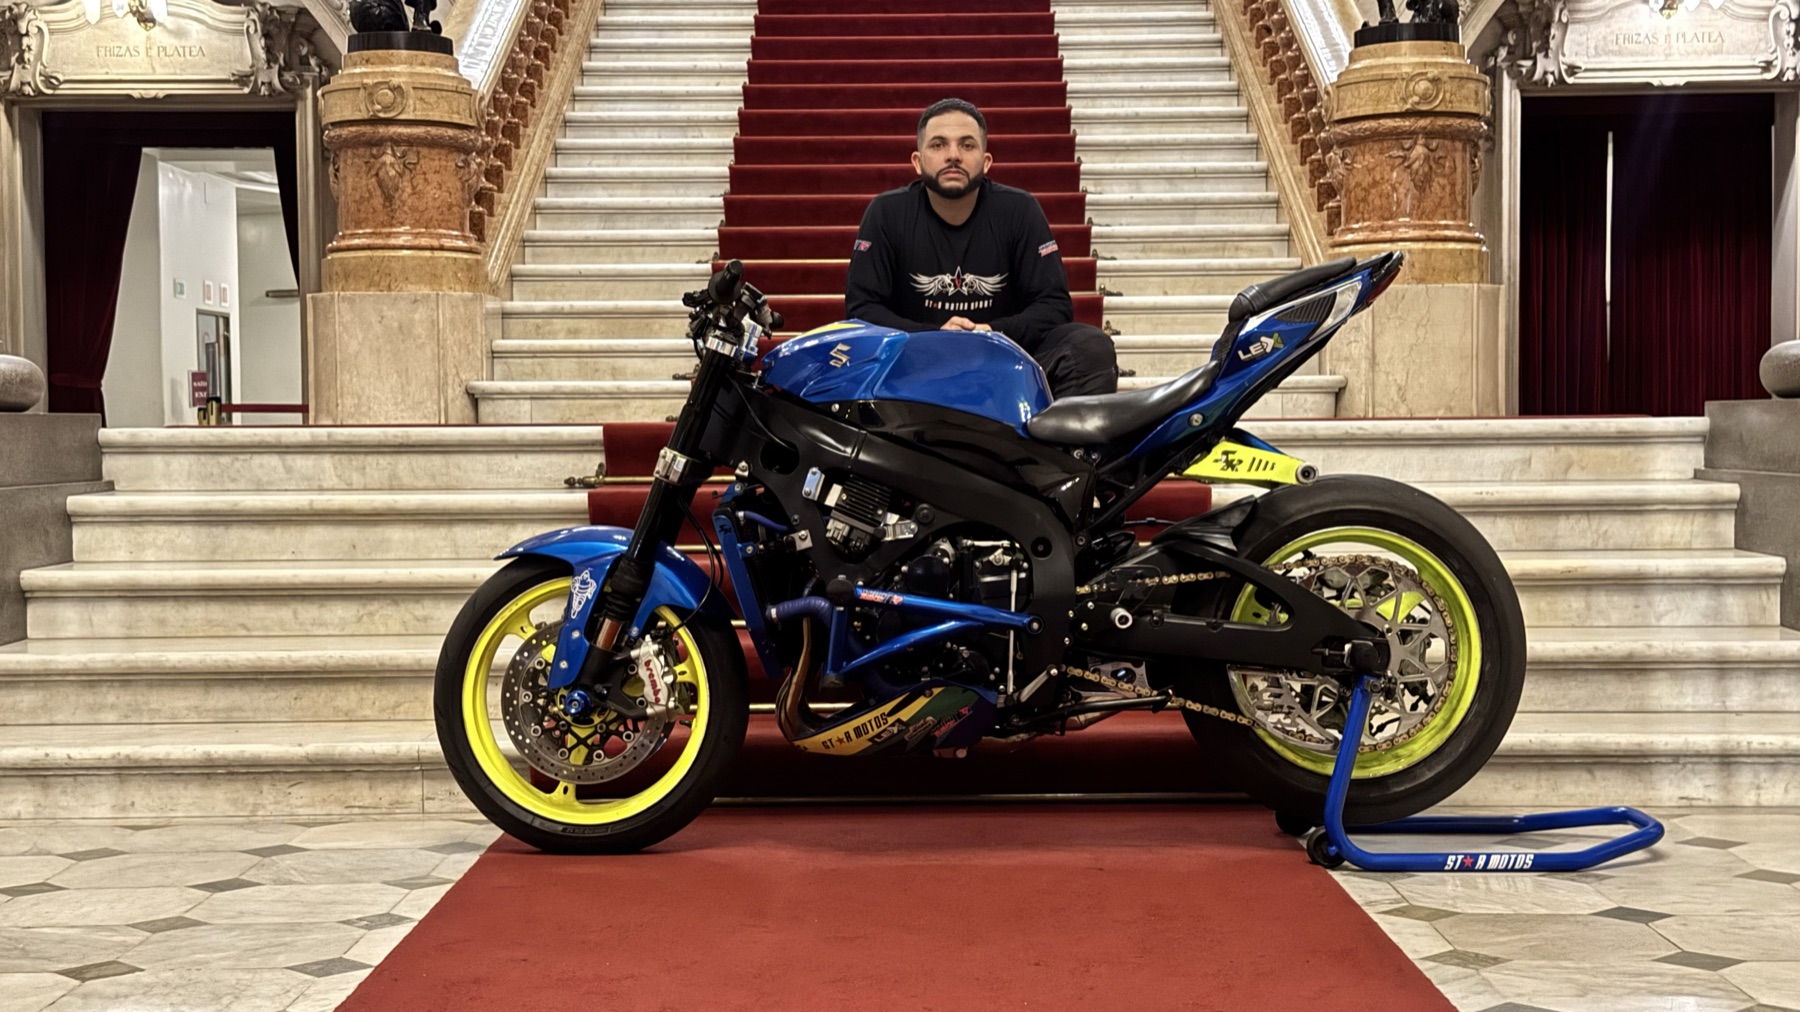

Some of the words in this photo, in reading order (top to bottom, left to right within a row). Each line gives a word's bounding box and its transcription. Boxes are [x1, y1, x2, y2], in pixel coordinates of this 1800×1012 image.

[96, 45, 140, 58] FRIZAS
[157, 45, 206, 58] PLATEA
[644, 659, 661, 704] brembo
[853, 711, 889, 740] MOTOS
[1486, 853, 1535, 870] MOTOS
